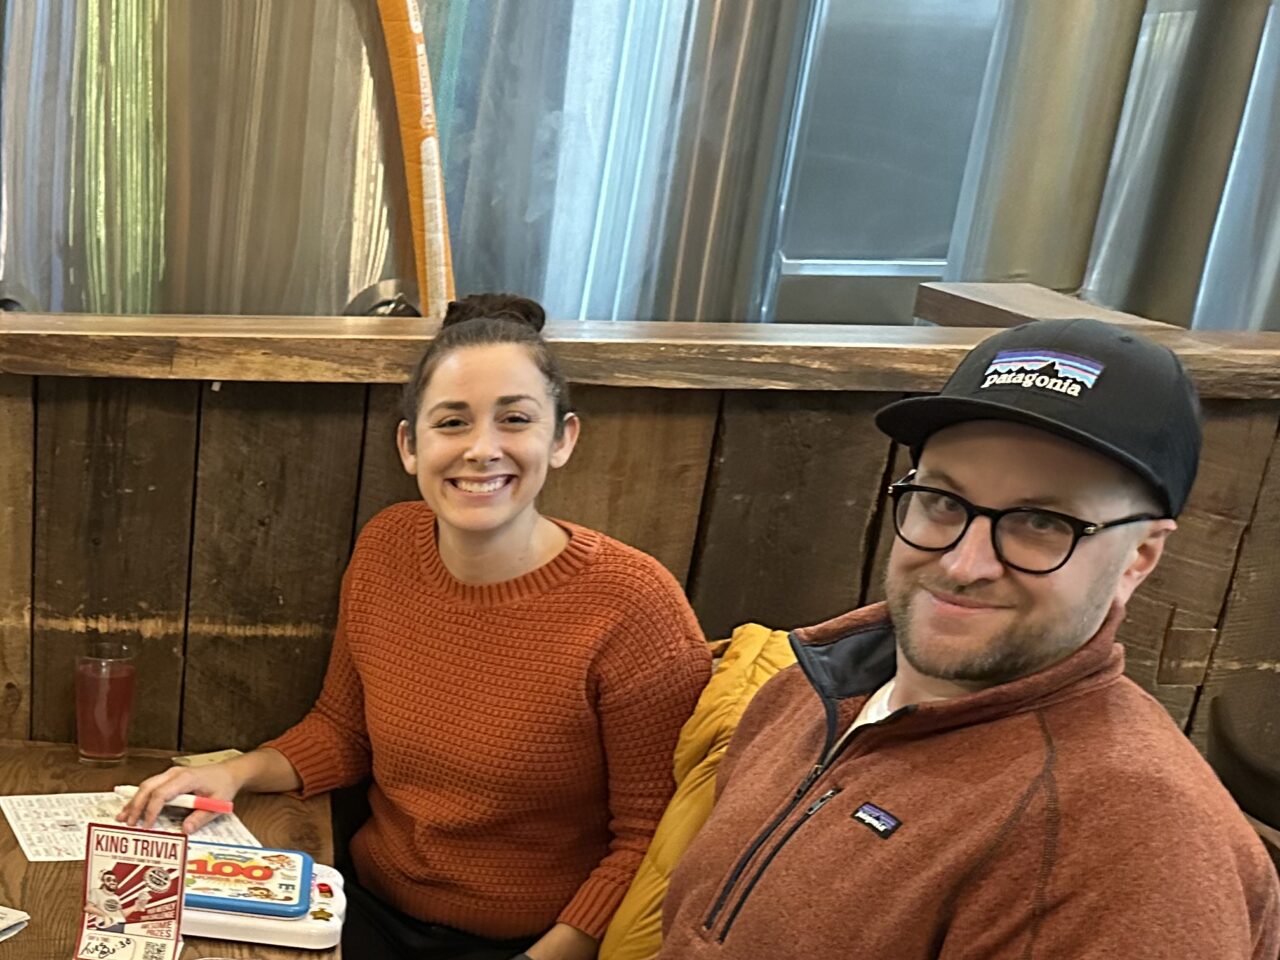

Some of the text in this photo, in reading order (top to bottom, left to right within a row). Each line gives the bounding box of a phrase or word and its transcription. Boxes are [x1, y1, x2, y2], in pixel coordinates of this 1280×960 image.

[980, 371, 1082, 397] patagonia
[95, 834, 129, 854] KING
[132, 838, 178, 860] TRIVIA
[185, 859, 274, 881] 100
